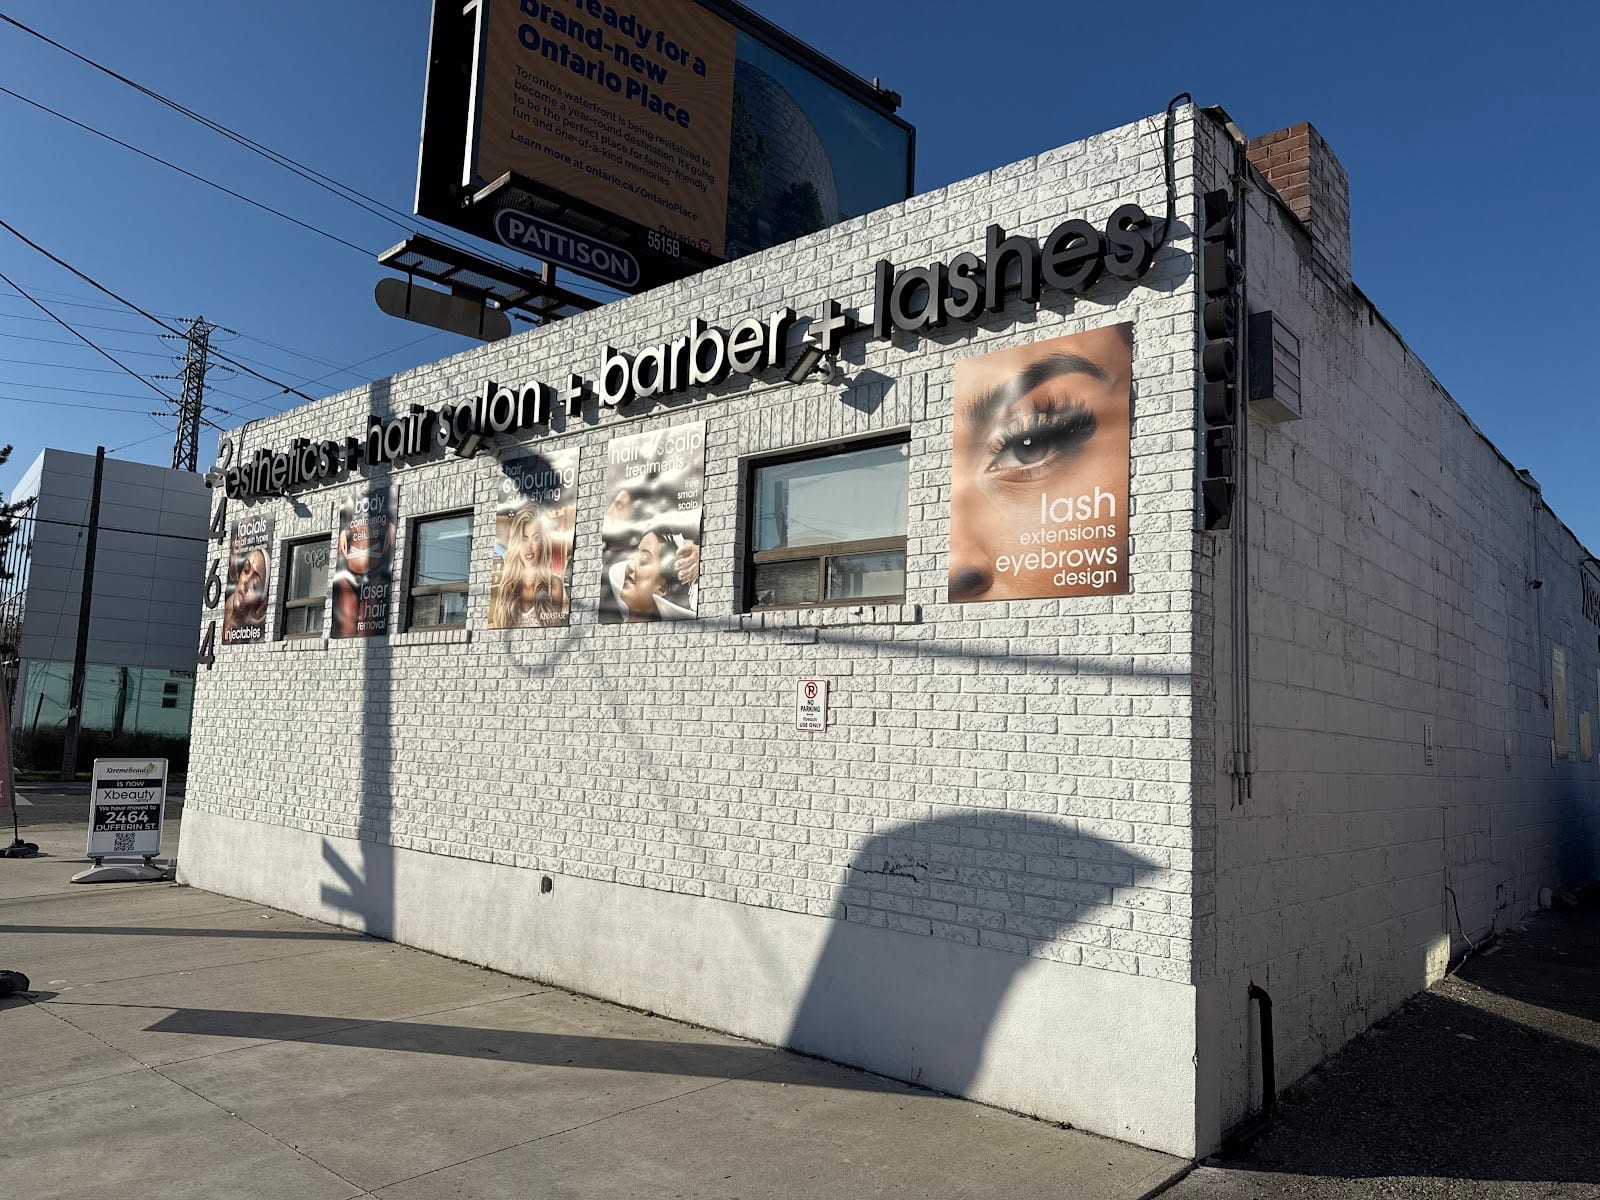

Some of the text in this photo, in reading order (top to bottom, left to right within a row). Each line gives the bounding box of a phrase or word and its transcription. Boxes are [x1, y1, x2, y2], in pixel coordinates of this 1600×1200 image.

[656, 30, 690, 66] for
[693, 56, 707, 78] a
[518, 23, 690, 128] Ontario Place
[516, 65, 711, 168] Toronto's waterfront is being revitalized to
[512, 106, 530, 122] fun
[532, 117, 552, 133] and
[555, 127, 622, 165] one-of-a-kind
[515, 78, 557, 106] become
[560, 102, 566, 110] a
[568, 106, 622, 137] year-round
[691, 166, 714, 184] going
[514, 92, 708, 192] to be the perfect place for family-friendly
[511, 130, 698, 221] Learn more at ontario.ca/OntarioPlace
[509, 217, 632, 279] PATTISON
[647, 230, 680, 258] 5515B
[226, 437, 338, 498] esthetics
[365, 404, 434, 466] hair
[436, 379, 550, 450] salon
[600, 306, 796, 408] barber
[874, 203, 1154, 341] lashes
[611, 442, 639, 464] hair
[656, 431, 701, 456] scalp
[505, 463, 523, 476] hair
[625, 458, 684, 477] treatments
[503, 468, 575, 493] colouring
[354, 493, 385, 514] body
[530, 487, 561, 503] styling
[677, 489, 698, 500] smart
[1041, 486, 1116, 524] lash
[678, 500, 698, 511] scalp
[237, 517, 267, 537] facials
[1020, 523, 1116, 545] extensions
[995, 546, 1118, 576] eyebrows
[1053, 568, 1117, 588] design
[360, 583, 388, 600] laser
[364, 600, 386, 618] hair
[225, 626, 261, 643] injectables
[357, 618, 386, 631] removal
[104, 789, 155, 800] Xbeauty
[96, 822, 158, 831] DUFFERIN ST.
[105, 811, 149, 823] 2464
